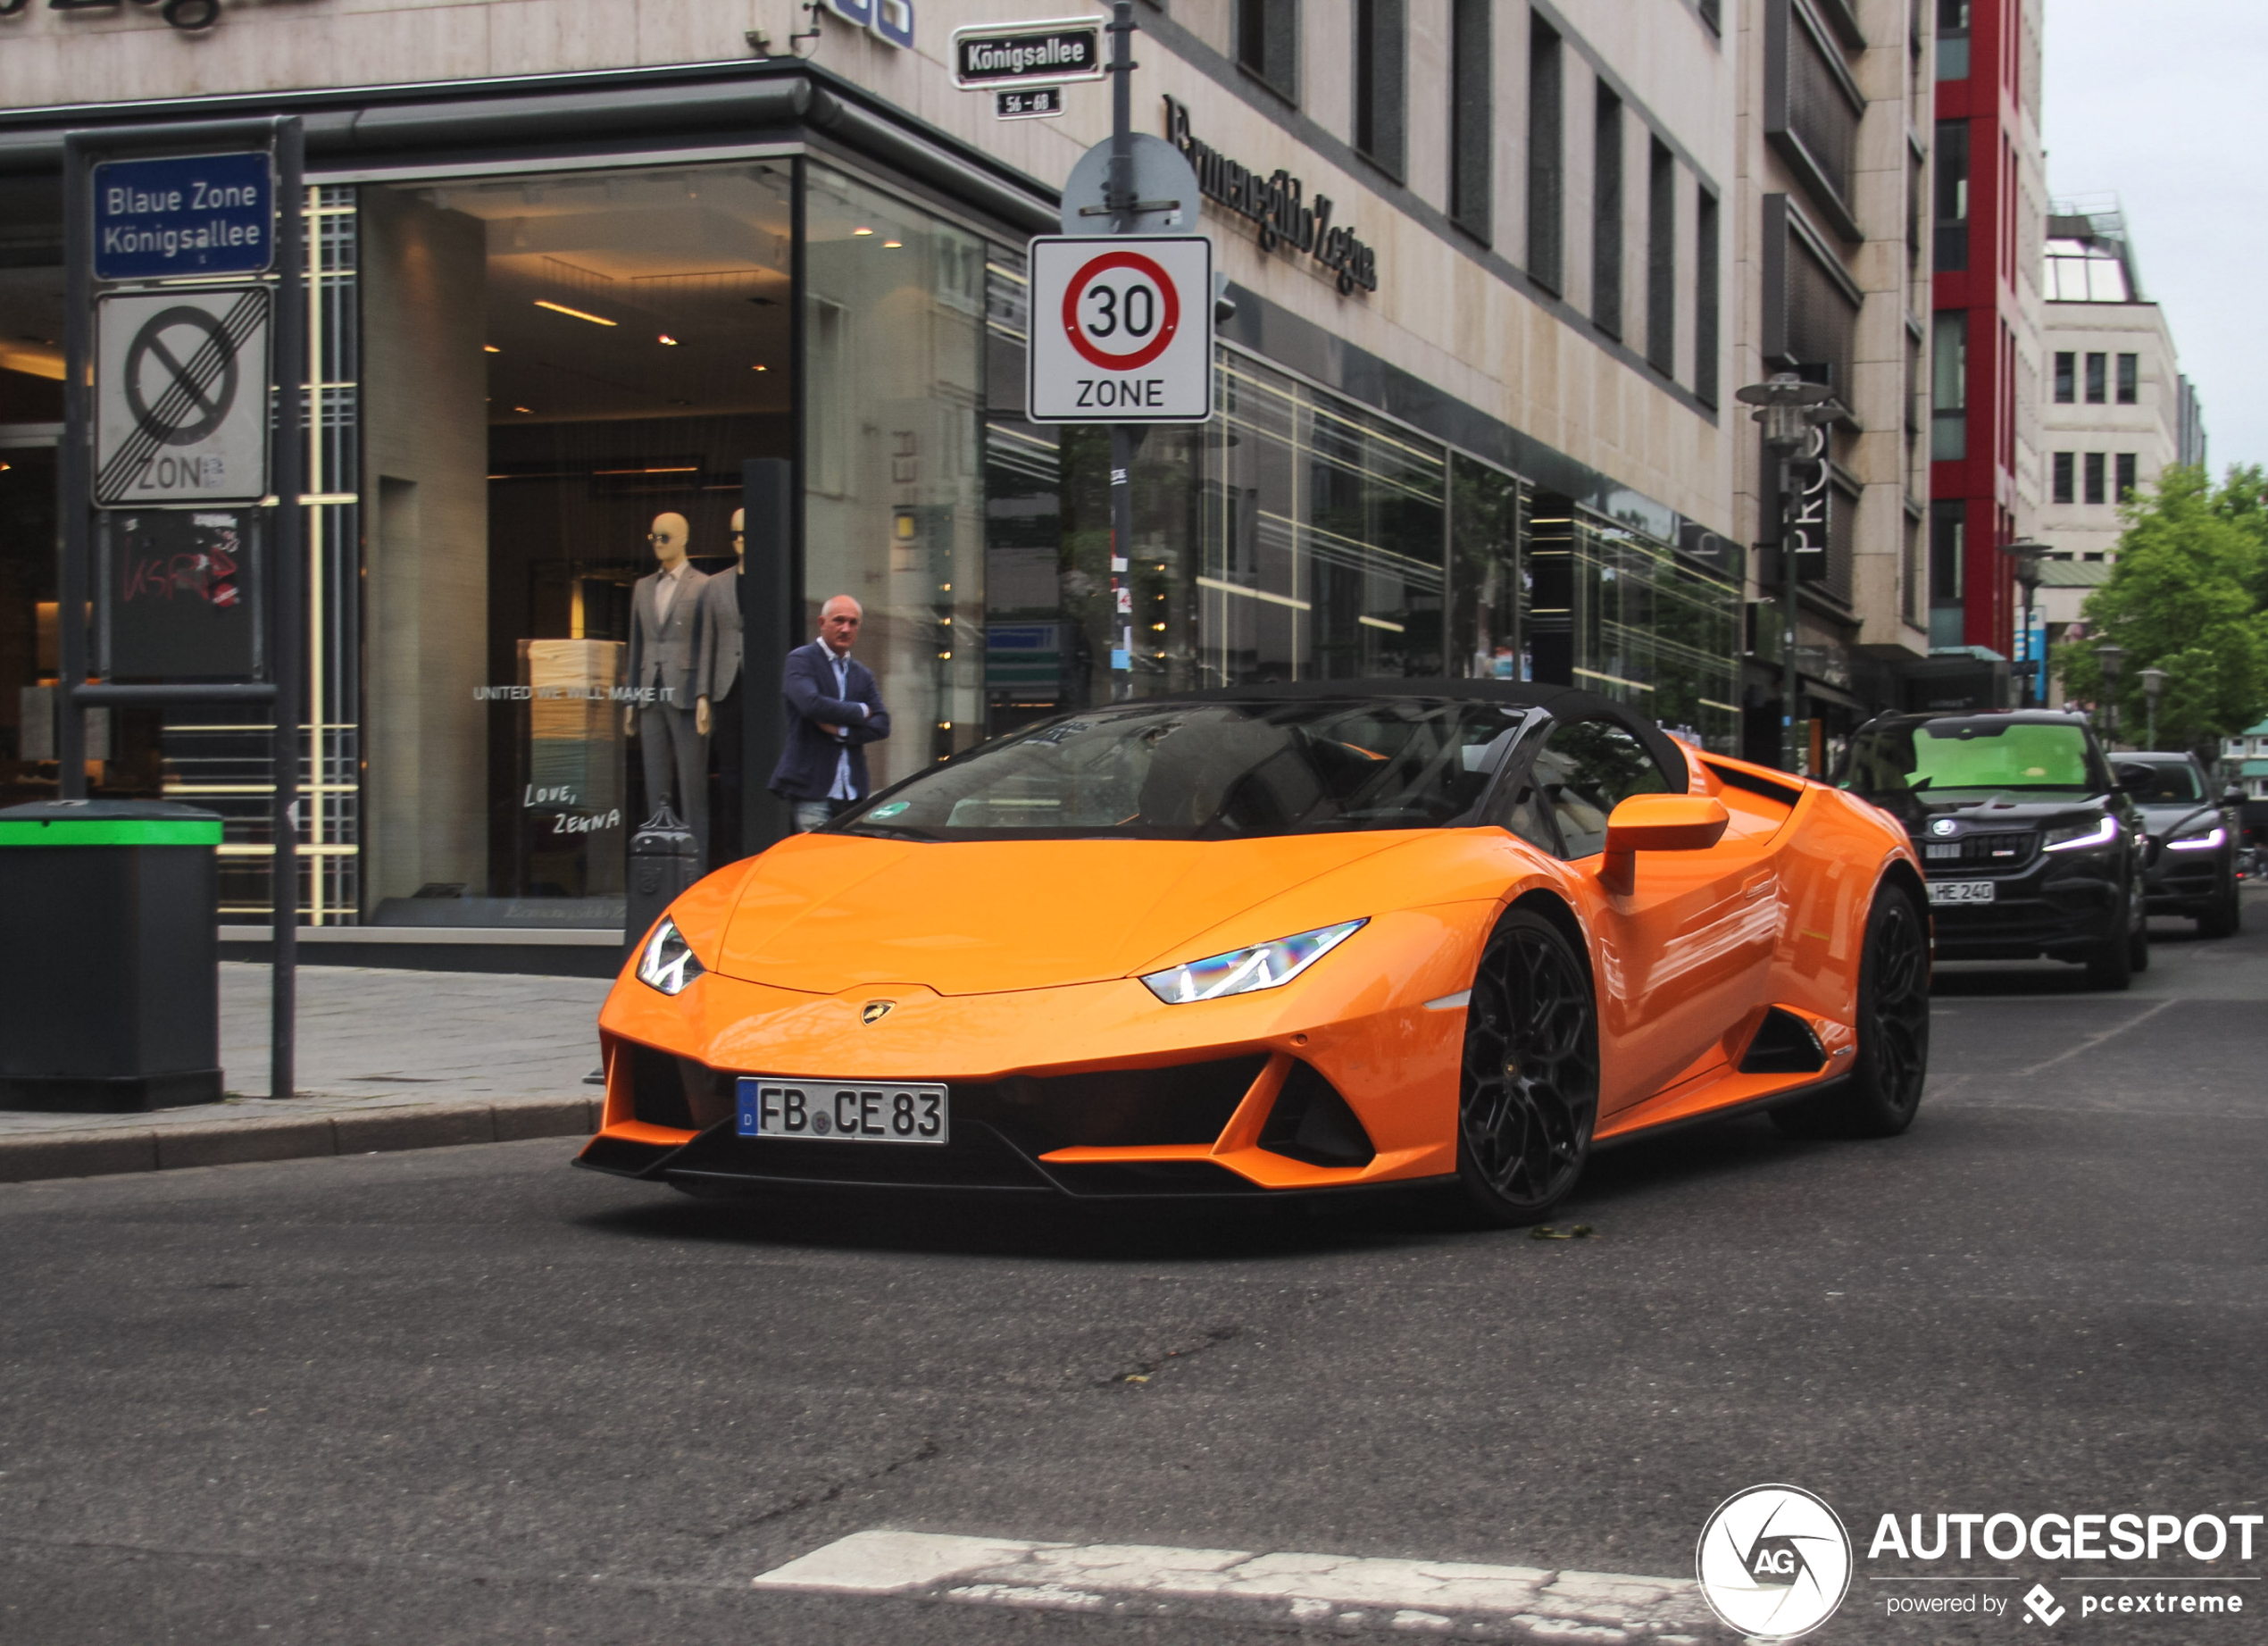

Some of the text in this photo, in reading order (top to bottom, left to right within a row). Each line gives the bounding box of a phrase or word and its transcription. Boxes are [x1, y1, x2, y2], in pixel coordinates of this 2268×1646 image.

[968, 38, 1085, 73] Königsallee
[107, 182, 257, 215] Blaue Zone
[104, 221, 260, 257] Königsallee
[1088, 284, 1154, 338] 30
[1076, 380, 1164, 407] ZONE
[472, 686, 676, 702] UNITED WE WILL MAKE IT
[744, 1113, 752, 1126] D
[760, 1087, 941, 1137] FB CE 83
